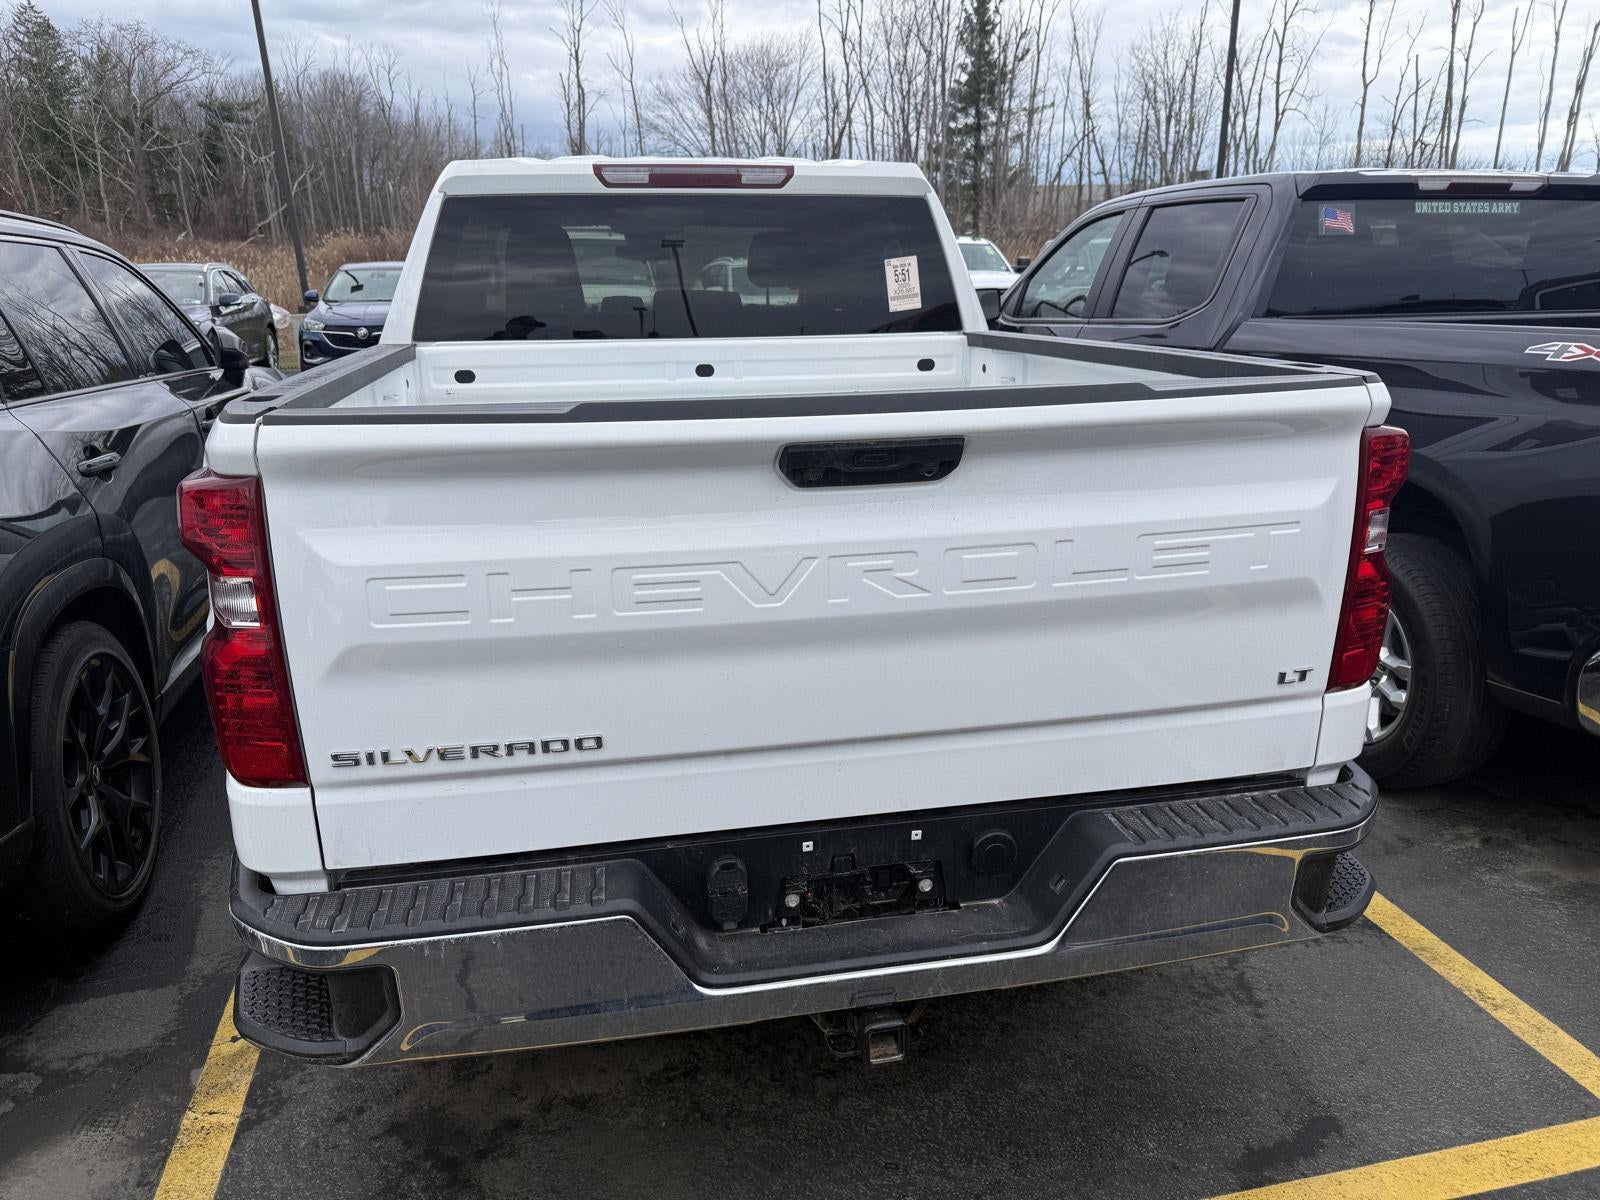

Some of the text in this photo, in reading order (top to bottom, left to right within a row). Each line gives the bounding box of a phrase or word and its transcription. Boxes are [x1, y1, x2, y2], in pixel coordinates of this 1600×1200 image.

[1415, 202, 1519, 213] UNITED STATES ARMY
[894, 268, 911, 283] 5:51
[365, 521, 1301, 628] CHEVROLET
[1277, 667, 1315, 685] LT
[330, 733, 604, 768] SILVERADO
